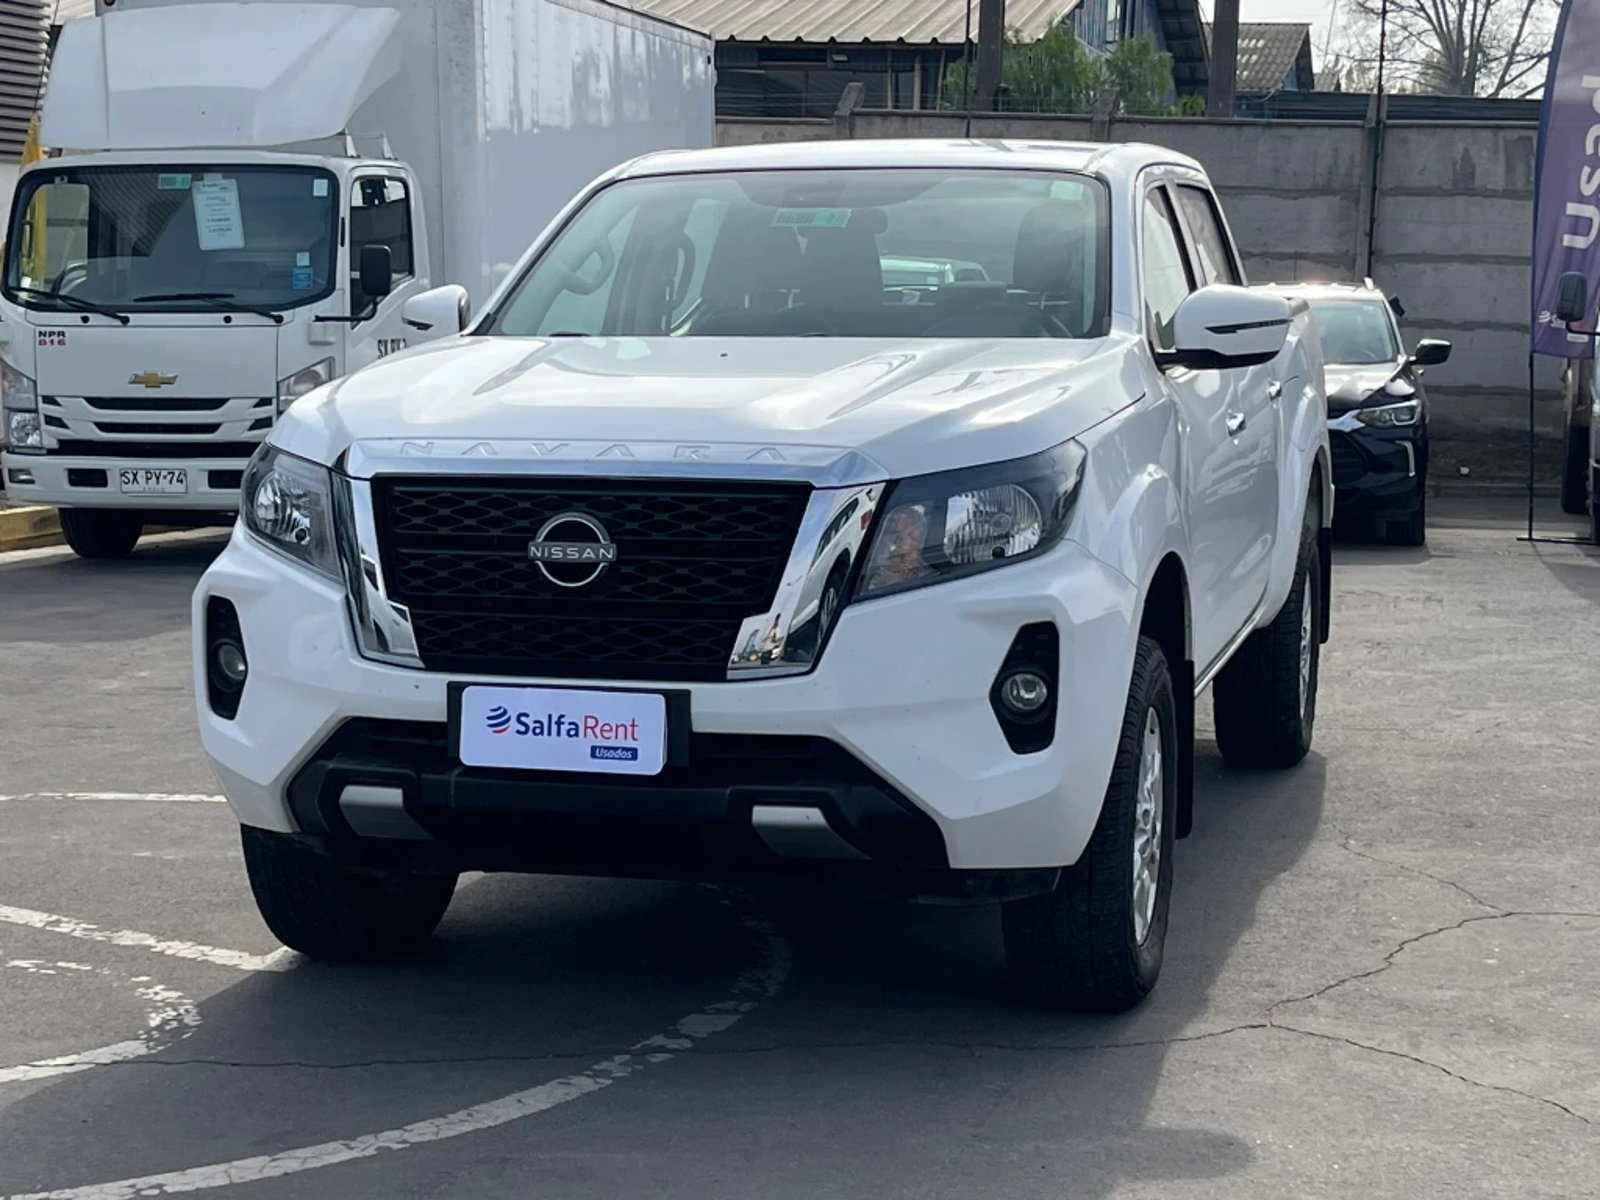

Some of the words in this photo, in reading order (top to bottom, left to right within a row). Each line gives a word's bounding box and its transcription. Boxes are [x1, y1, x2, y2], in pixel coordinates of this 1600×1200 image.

[400, 441, 787, 462] NAVARA
[530, 546, 614, 559] NISSAN
[515, 712, 639, 742] SalfaRent
[595, 747, 632, 759] Usados
